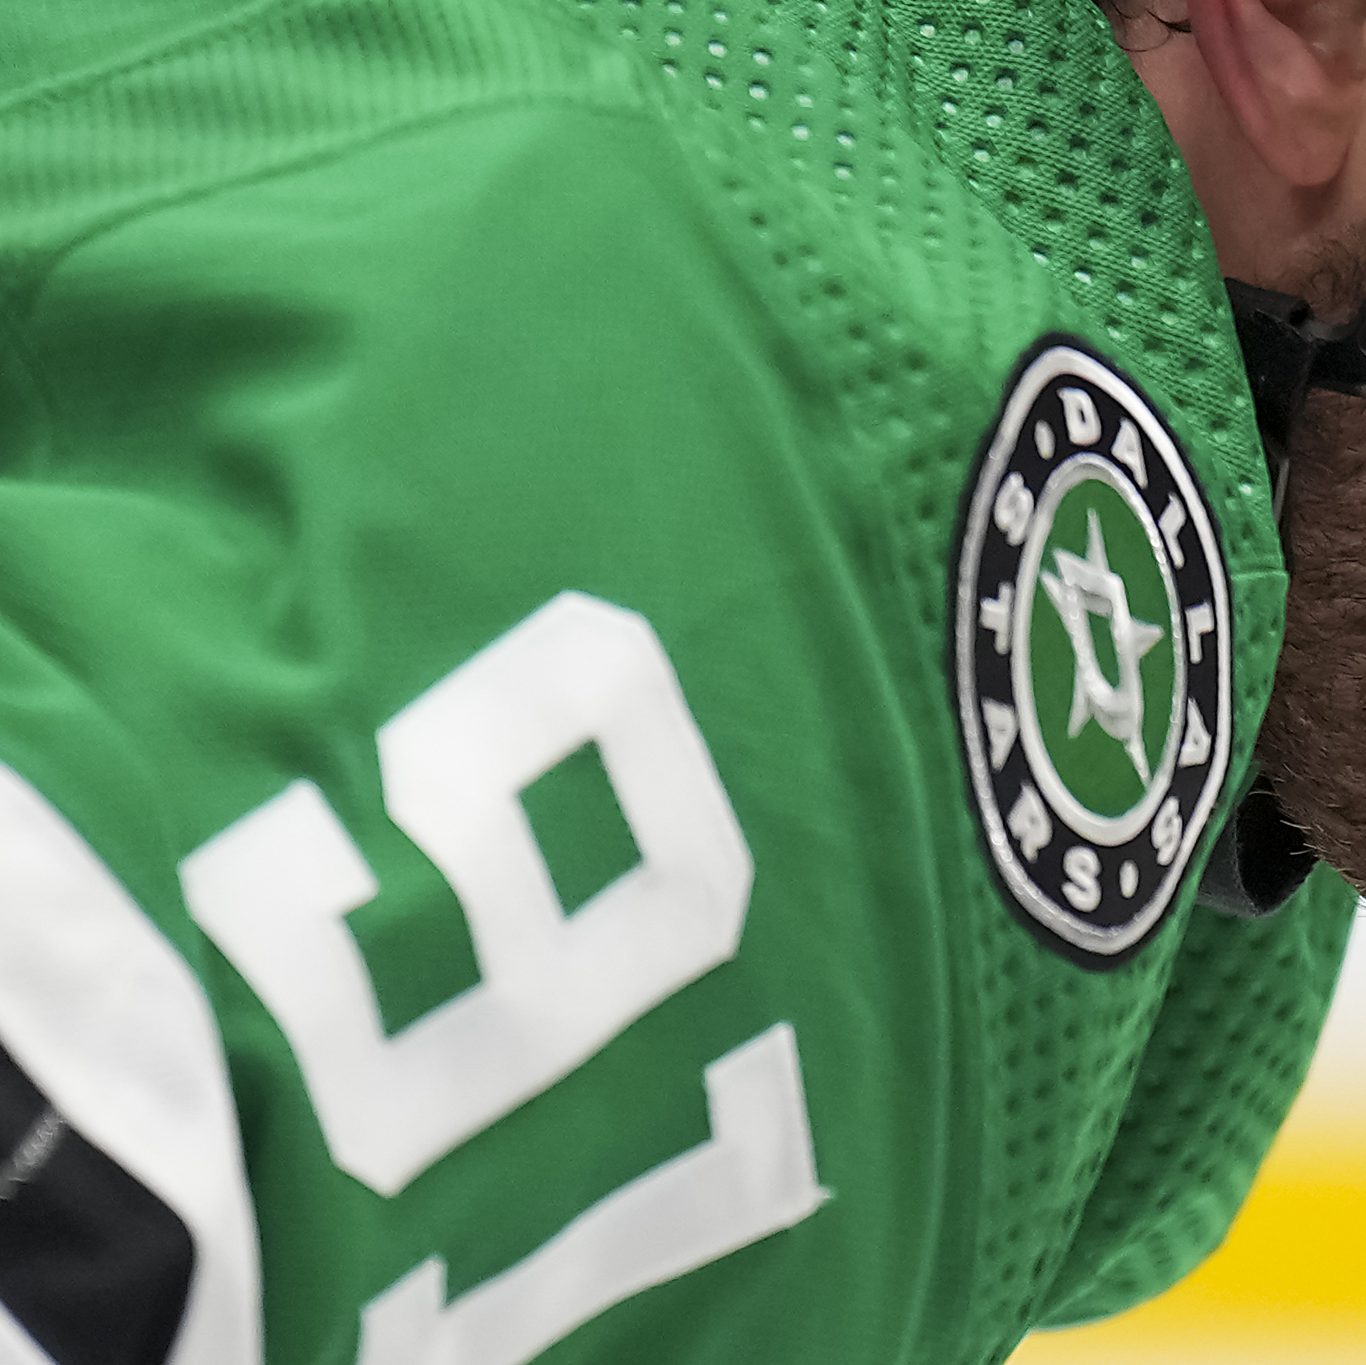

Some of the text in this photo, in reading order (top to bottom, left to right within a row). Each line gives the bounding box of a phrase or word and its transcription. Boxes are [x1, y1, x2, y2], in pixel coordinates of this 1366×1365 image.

[979, 471, 1102, 913] STARS
[1057, 387, 1214, 866] DALLAS
[177, 589, 834, 1365] 91
